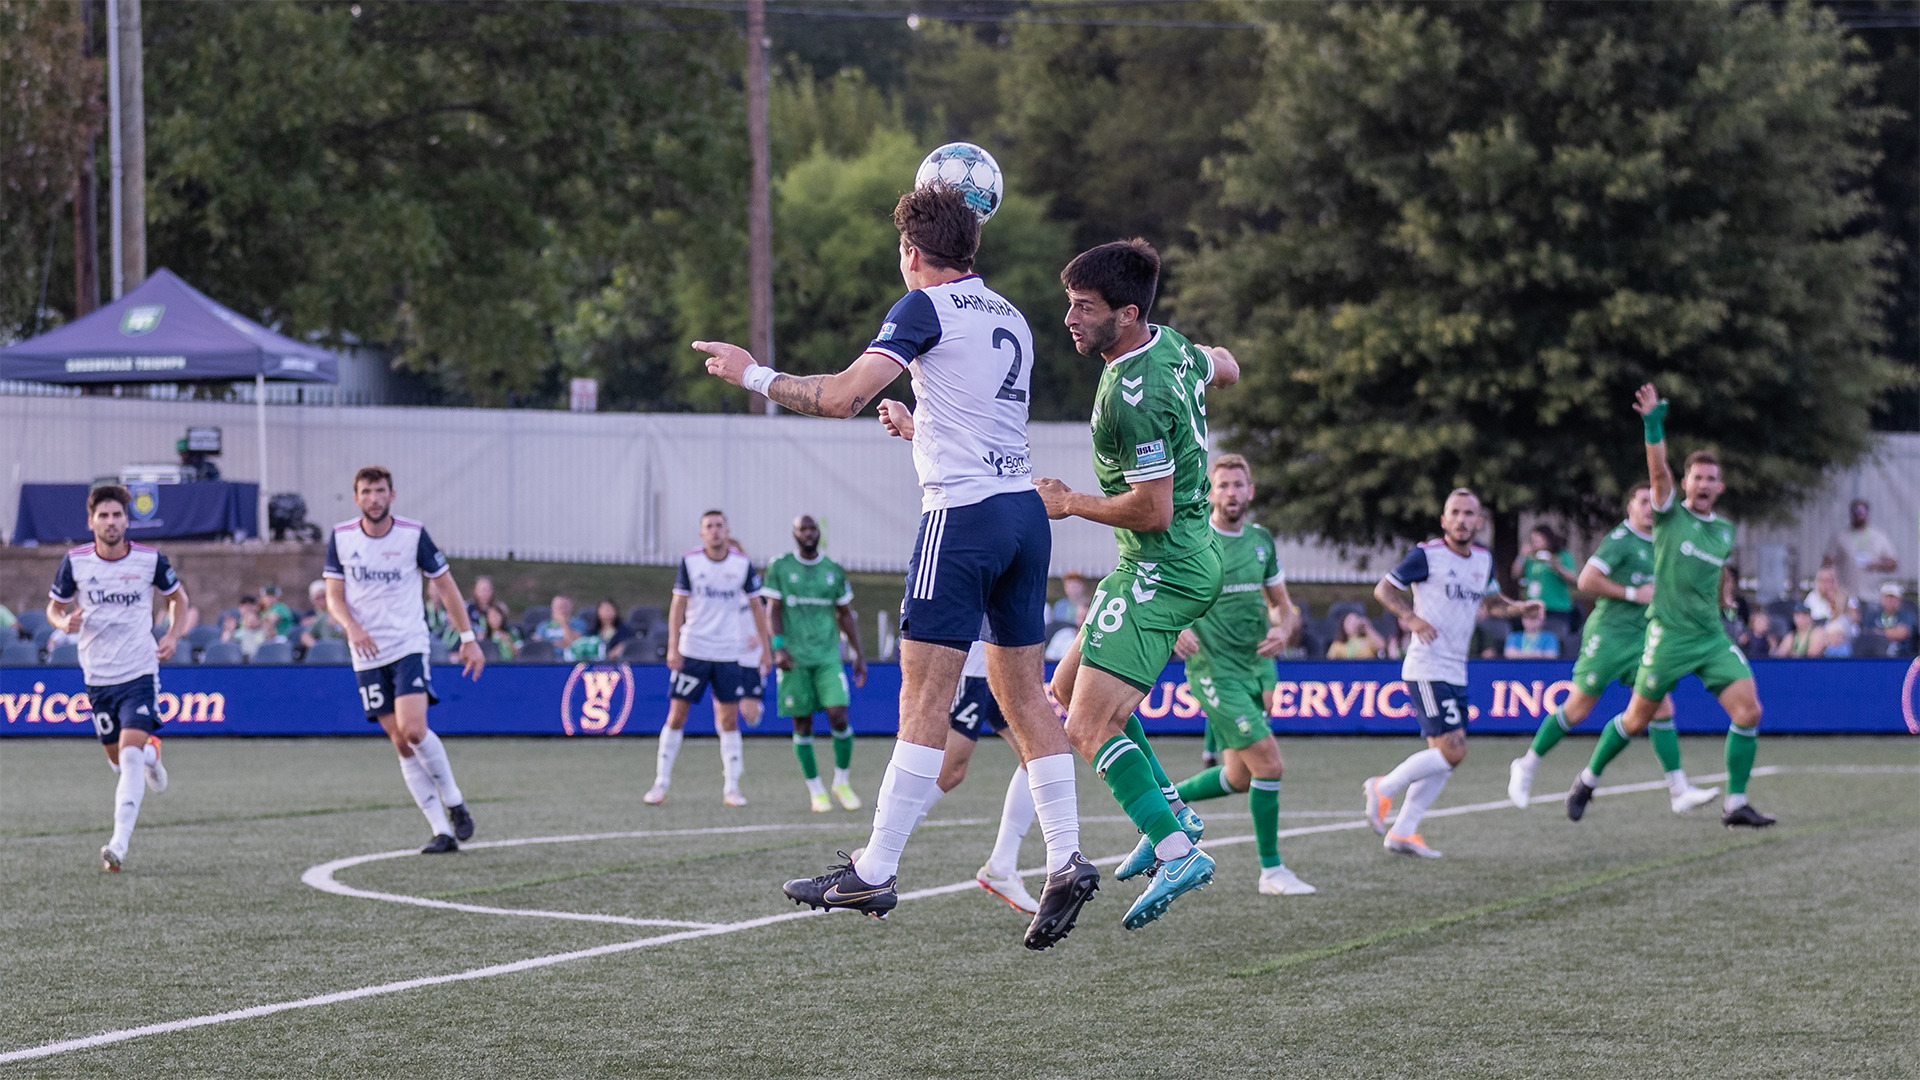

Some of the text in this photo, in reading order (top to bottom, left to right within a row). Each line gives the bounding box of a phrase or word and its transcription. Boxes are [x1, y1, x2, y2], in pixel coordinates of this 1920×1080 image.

[992, 327, 1027, 403] 2
[1086, 590, 1127, 633] 18
[359, 683, 385, 711] 15
[955, 702, 979, 730] 4
[1441, 698, 1461, 725] 3
